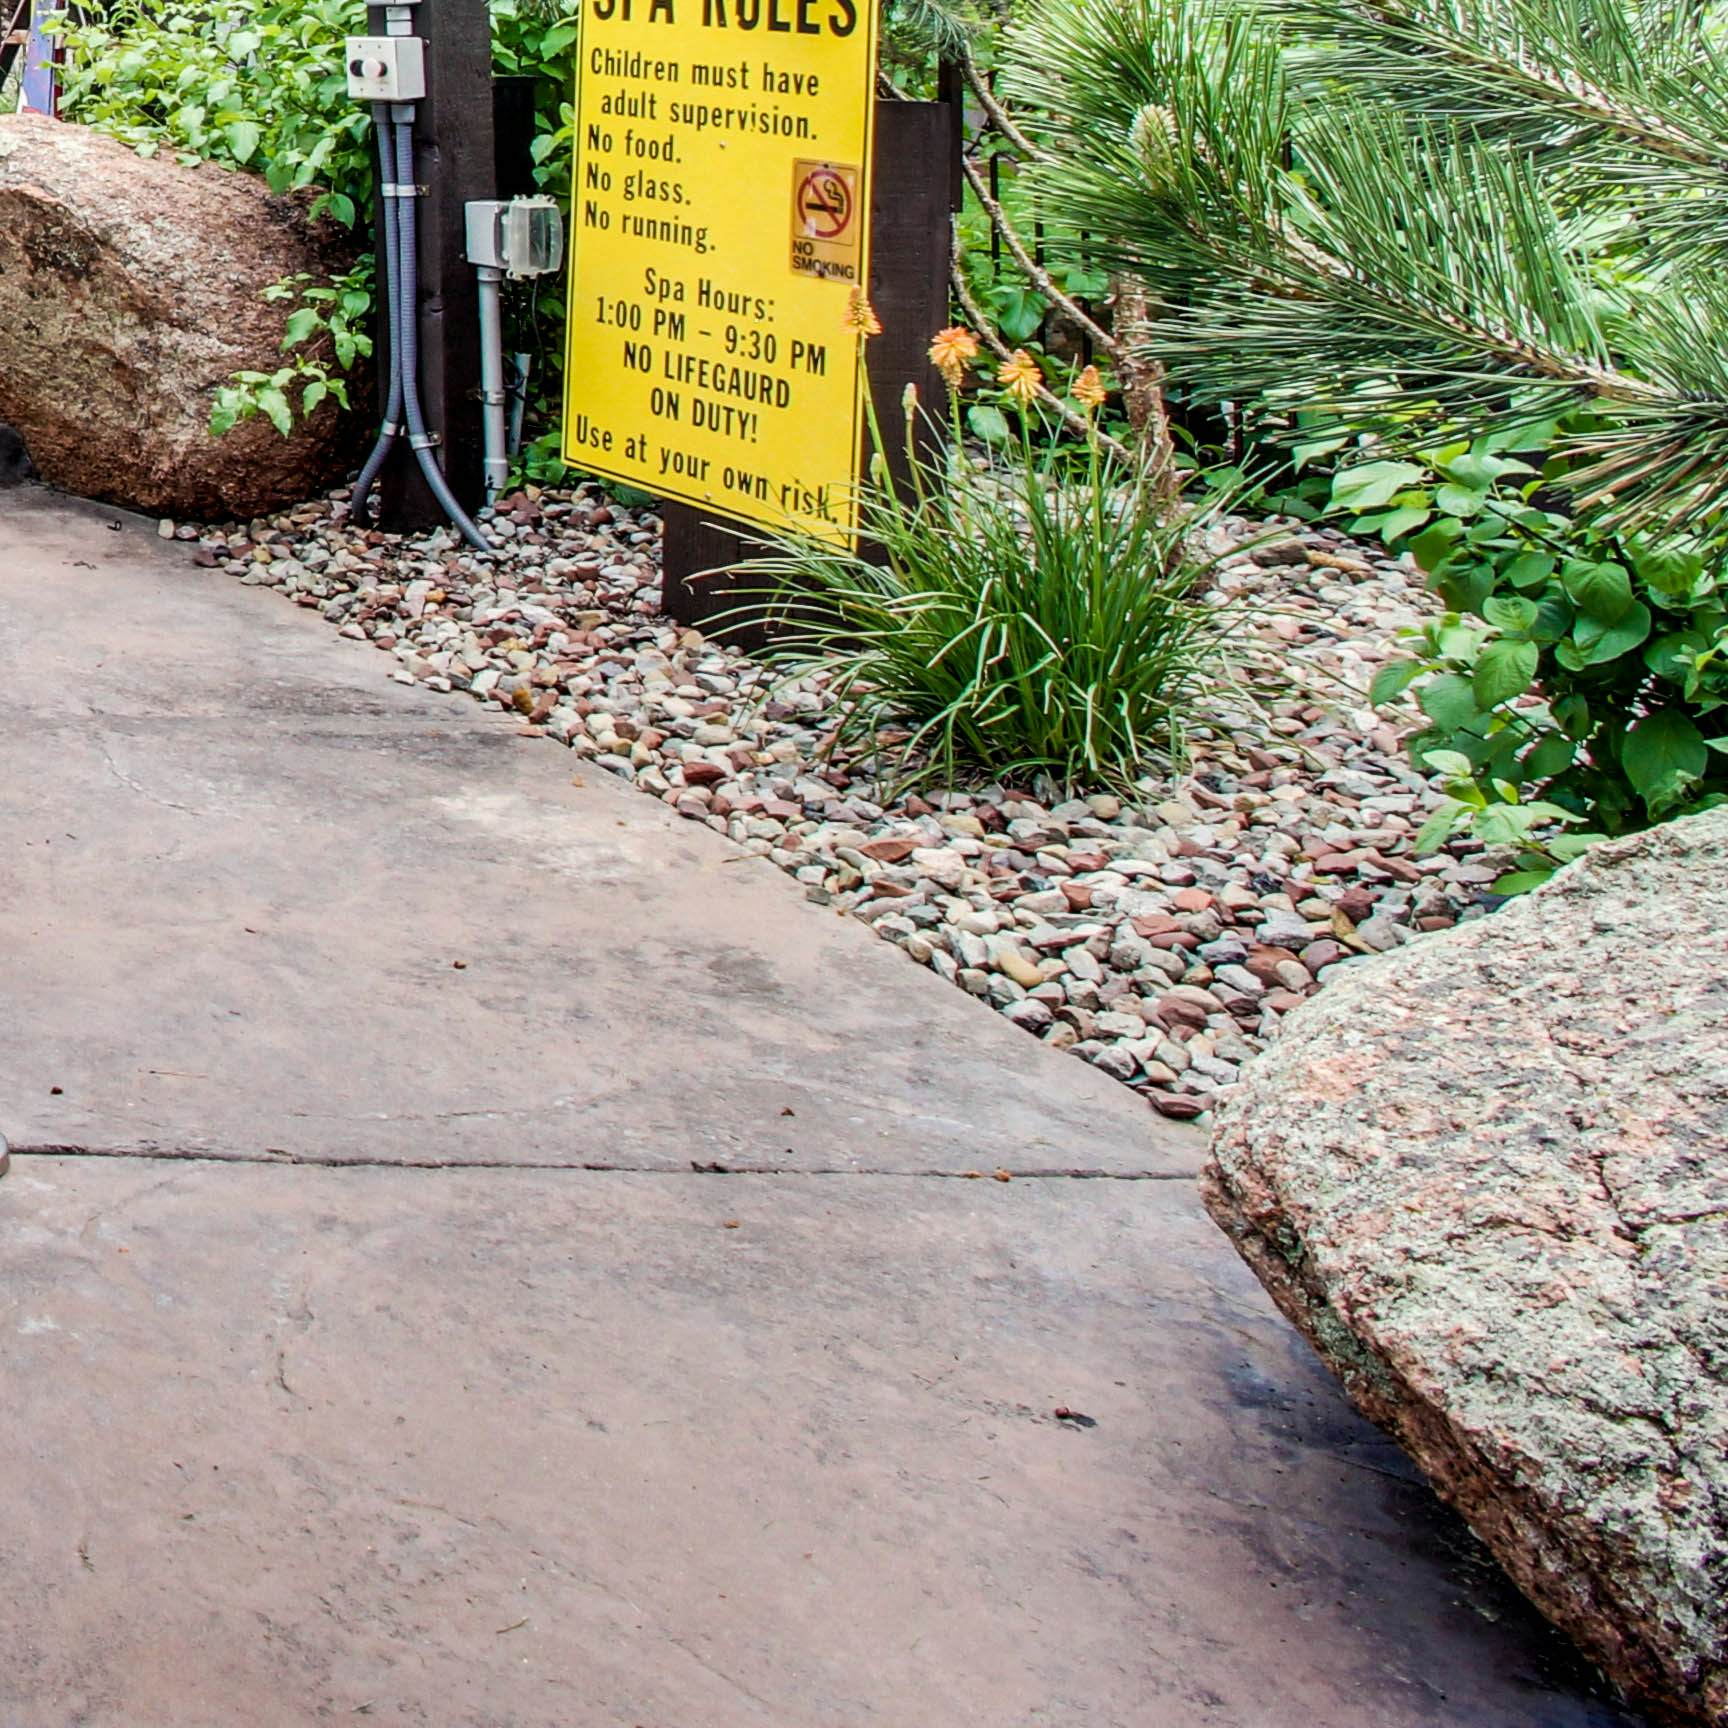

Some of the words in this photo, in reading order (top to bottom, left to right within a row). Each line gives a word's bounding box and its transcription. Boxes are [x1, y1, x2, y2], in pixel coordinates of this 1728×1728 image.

[591, 47, 679, 83] Children
[691, 60, 750, 91] must
[762, 62, 820, 97] have
[600, 89, 657, 120] adult
[669, 100, 818, 141] supervision.
[587, 123, 613, 153] No
[625, 129, 682, 164] food.
[586, 162, 611, 192] No
[623, 170, 692, 206] glass.
[584, 200, 610, 230] No
[622, 213, 716, 255] running.
[792, 239, 814, 256] NO
[792, 255, 855, 280] SMOKING
[644, 267, 685, 303] Spa
[697, 278, 775, 322] Hours:
[596, 296, 641, 332] 1:00
[653, 308, 686, 342] PM
[725, 324, 777, 364] 9:30
[790, 339, 827, 377] PM
[623, 340, 652, 374] NO
[664, 350, 791, 409] LIFEGAURD
[650, 387, 680, 422] ON
[692, 398, 758, 444] DUTY!
[575, 414, 613, 452] Use
[625, 433, 648, 464] at
[659, 446, 711, 482] your
[723, 466, 768, 502] own
[781, 479, 838, 524] risk.
